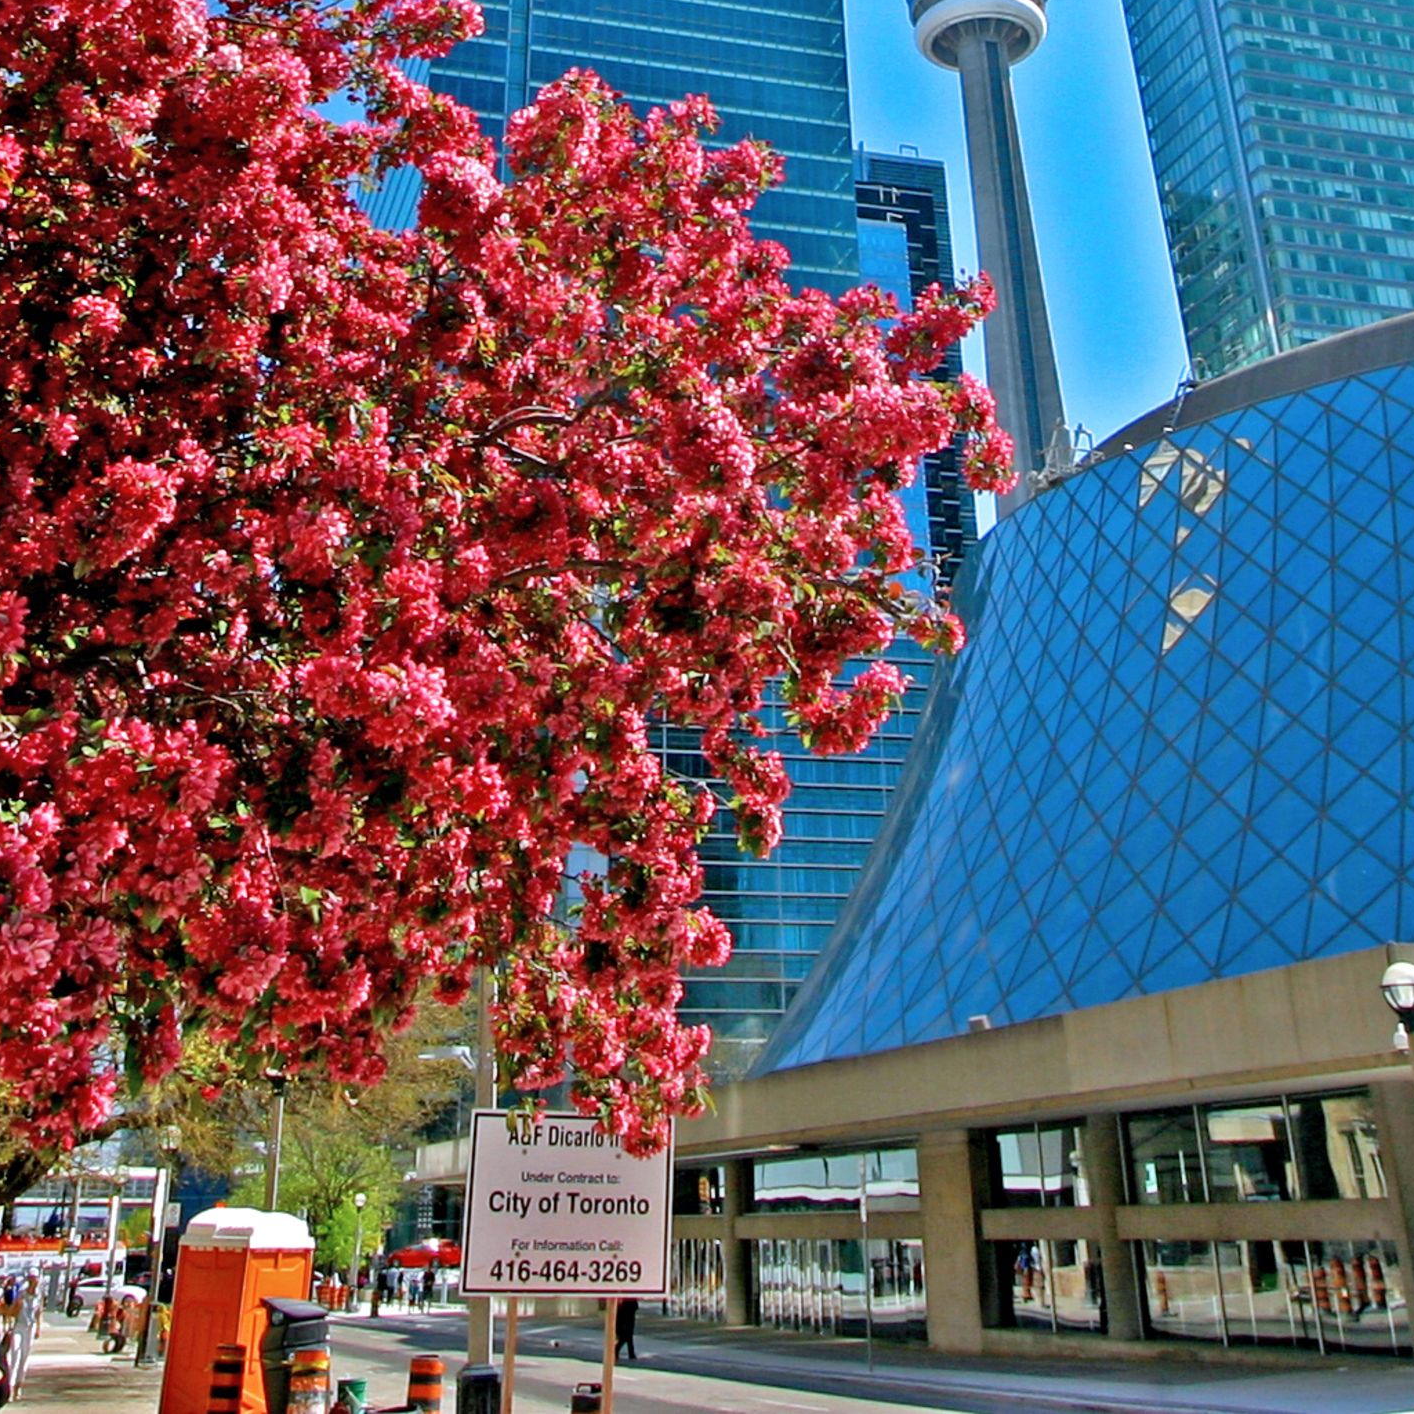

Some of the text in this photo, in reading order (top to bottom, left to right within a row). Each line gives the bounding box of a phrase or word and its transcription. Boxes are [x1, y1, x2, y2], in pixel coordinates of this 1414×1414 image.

[548, 1125, 604, 1147] Dicarlo
[521, 1171, 621, 1184] Under Contract to:
[489, 1190, 650, 1219] City of Toronto
[511, 1239, 624, 1252] For Information Call:
[490, 1260, 642, 1283] 416-464-3269
